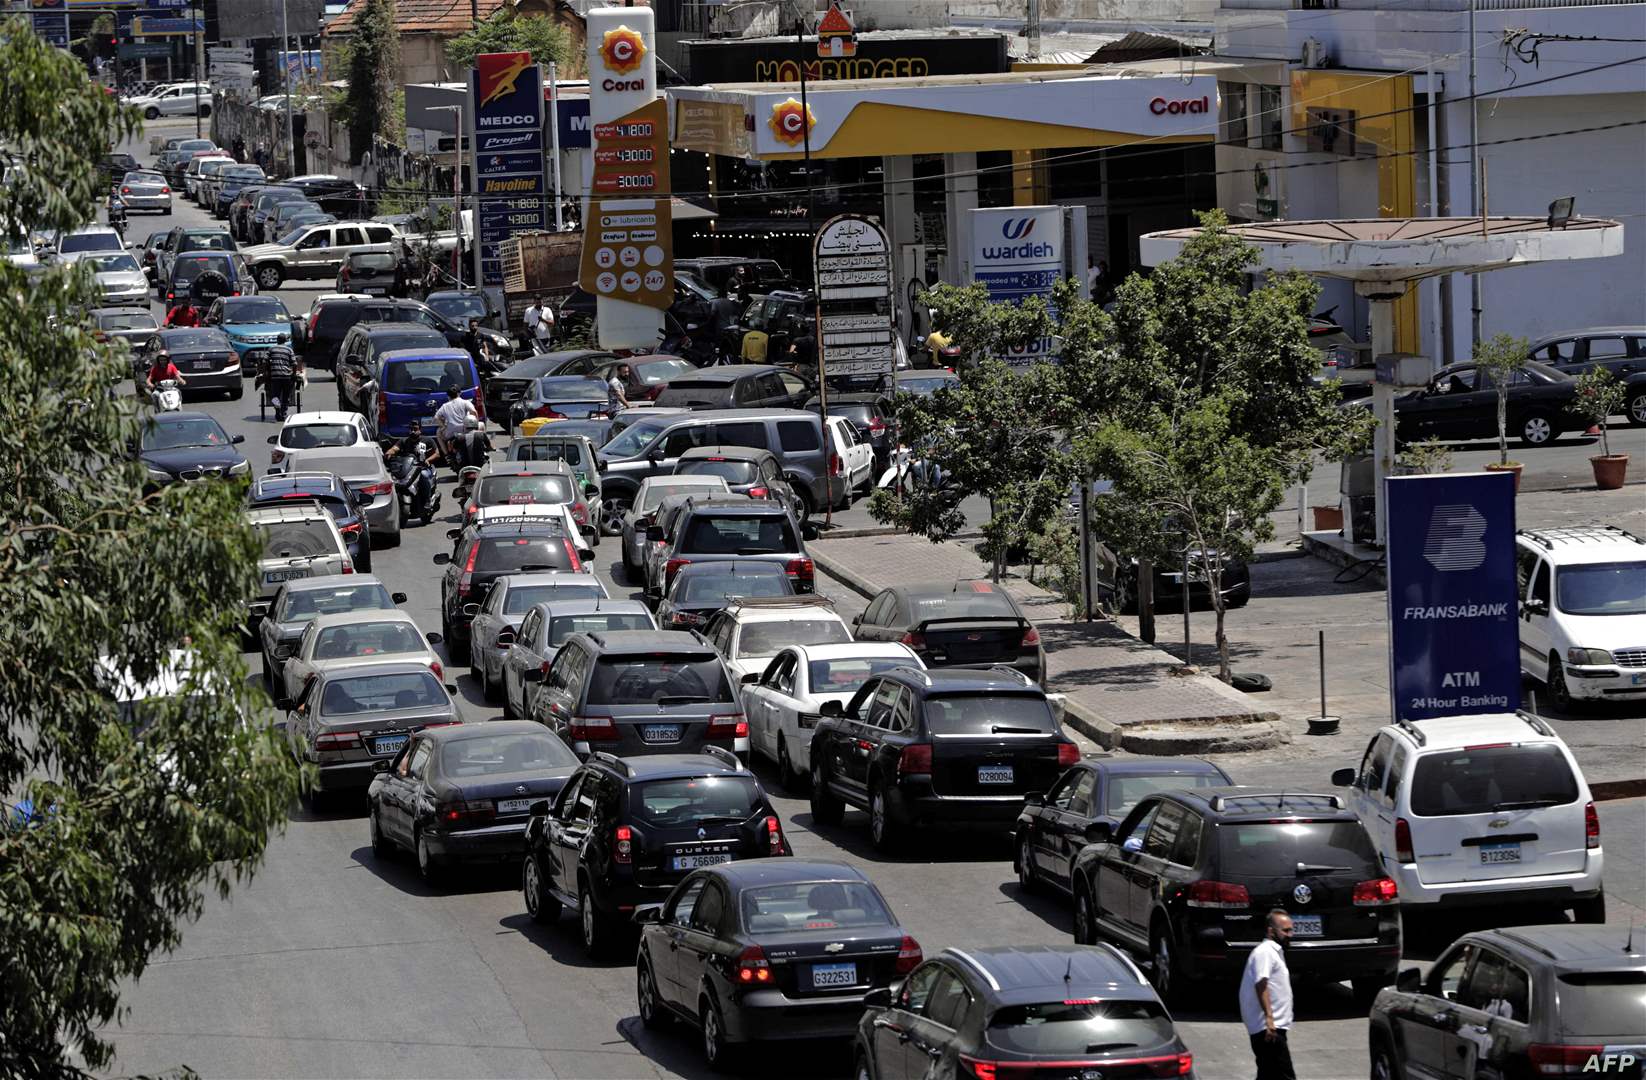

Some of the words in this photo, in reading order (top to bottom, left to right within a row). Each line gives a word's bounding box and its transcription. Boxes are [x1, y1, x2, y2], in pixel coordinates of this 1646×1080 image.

[602, 78, 645, 92] Coral
[1150, 95, 1209, 115] Coral
[480, 115, 535, 125] MEDCO
[616, 149, 653, 161] 43000
[485, 178, 536, 192] Havoline
[618, 174, 654, 188] 30000
[983, 242, 1054, 259] wardieh
[646, 276, 664, 285] 24/7
[1404, 602, 1508, 619] FRANSABANK
[1442, 671, 1480, 688] ATM
[1411, 698, 1425, 709] 24
[1427, 697, 1456, 709] Hour
[1461, 695, 1508, 707] Banking
[814, 970, 856, 985] G322531
